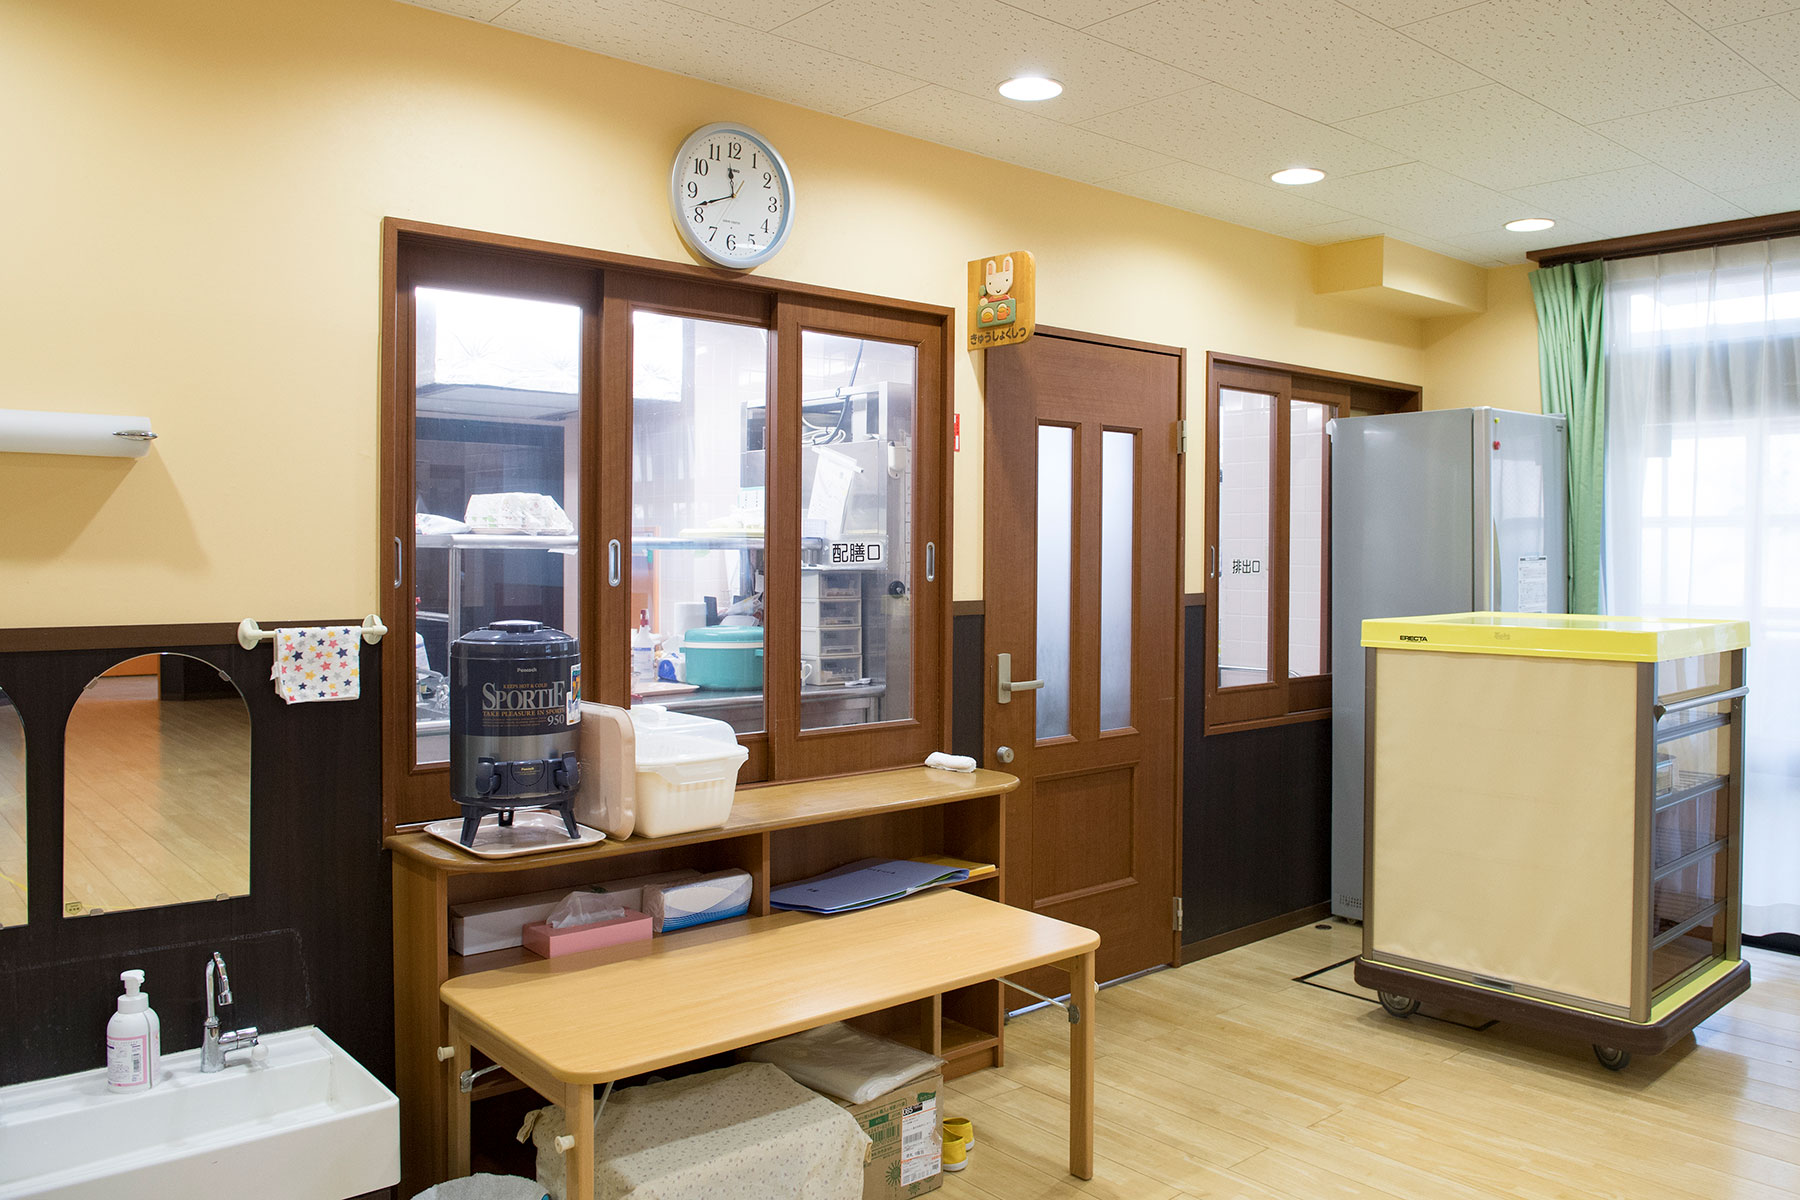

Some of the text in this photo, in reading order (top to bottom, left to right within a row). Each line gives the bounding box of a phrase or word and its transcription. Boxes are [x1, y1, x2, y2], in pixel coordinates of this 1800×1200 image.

[709, 143, 721, 162] 11
[727, 141, 742, 160] 12
[693, 157, 709, 177] 10
[751, 153, 757, 169] 1
[763, 171, 772, 189] 2
[687, 181, 698, 199] 9
[767, 196, 778, 213] 3
[693, 206, 704, 223] 8
[708, 225, 718, 242] 7
[760, 218, 769, 234] 4
[726, 233, 736, 251] 6
[748, 233, 756, 246] 5
[970, 326, 1027, 345] きゅうしょくしつ
[832, 543, 880, 563] 配膳口
[1232, 559, 1261, 574] 排出口
[547, 714, 565, 727] 950
